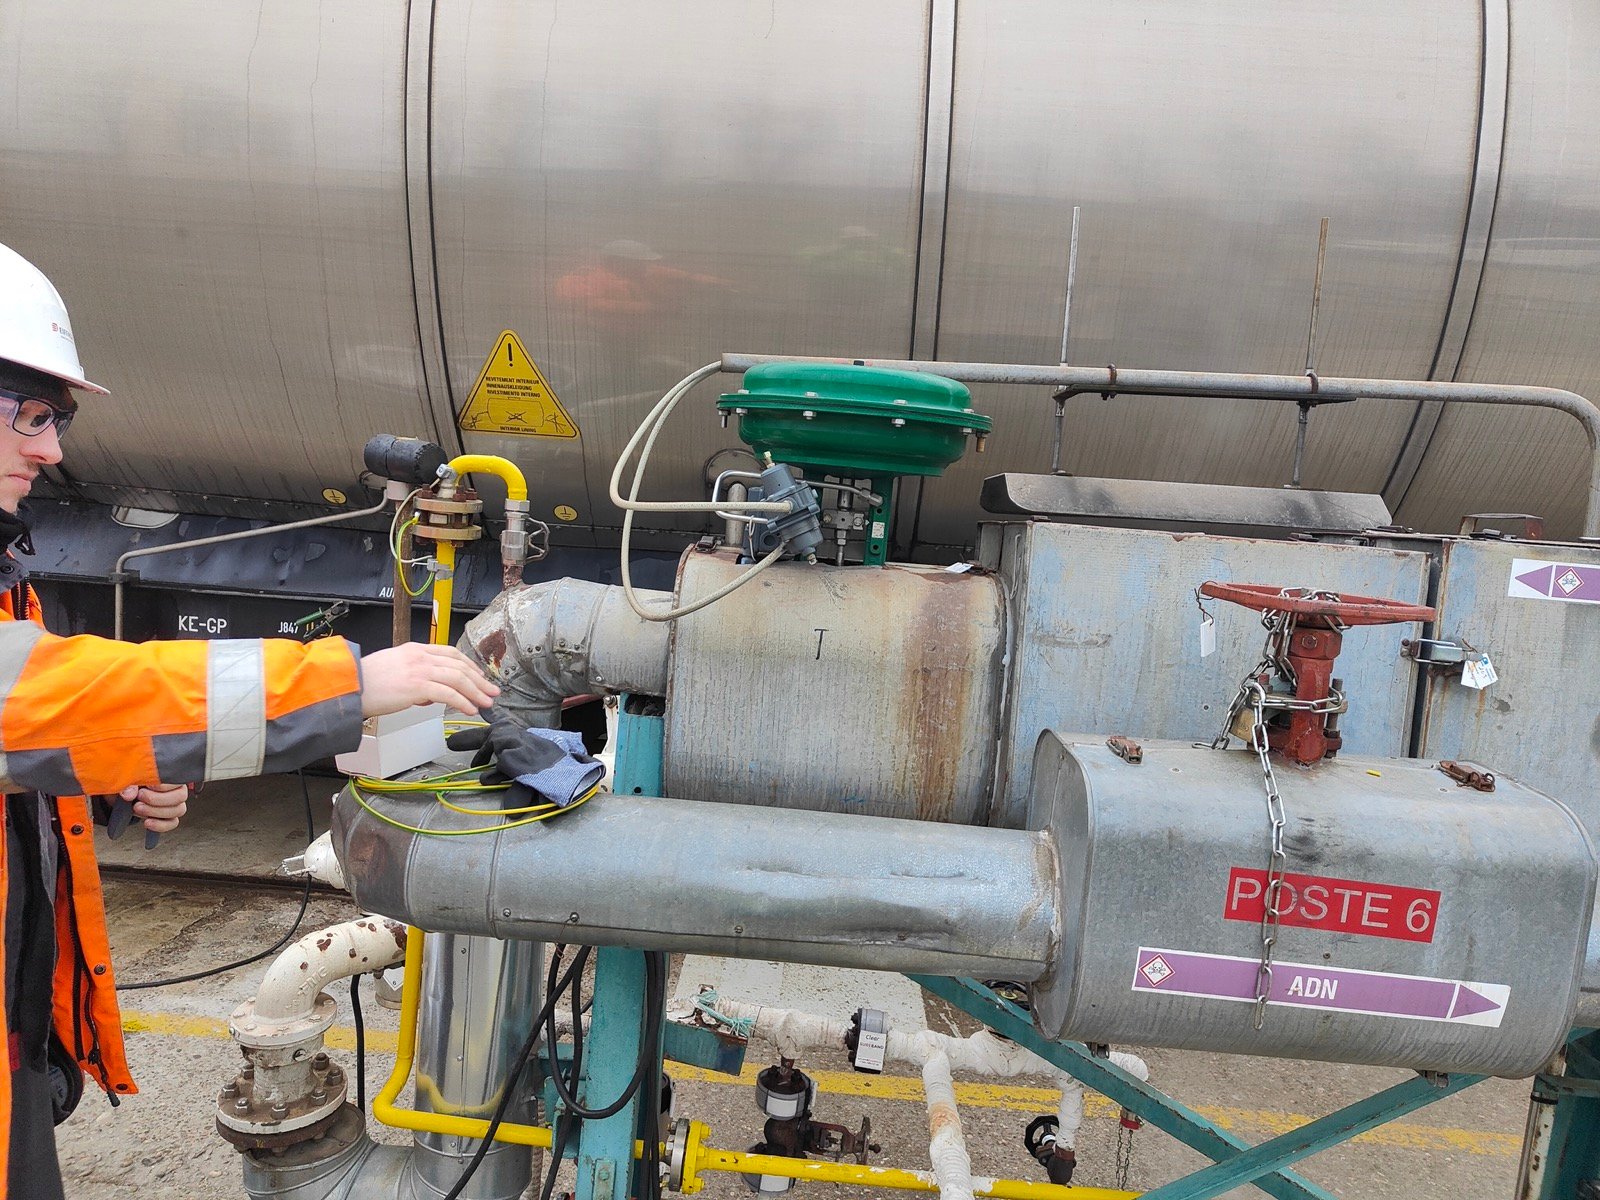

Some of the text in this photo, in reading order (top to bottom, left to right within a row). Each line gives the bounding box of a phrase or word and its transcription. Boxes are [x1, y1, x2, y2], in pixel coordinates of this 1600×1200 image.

[487, 389, 520, 397] RIVESTIMENTO
[379, 586, 395, 598] AU
[178, 615, 228, 634] KE-GP
[1231, 876, 1433, 933] POSTE 6
[1287, 975, 1339, 1000] ADN
